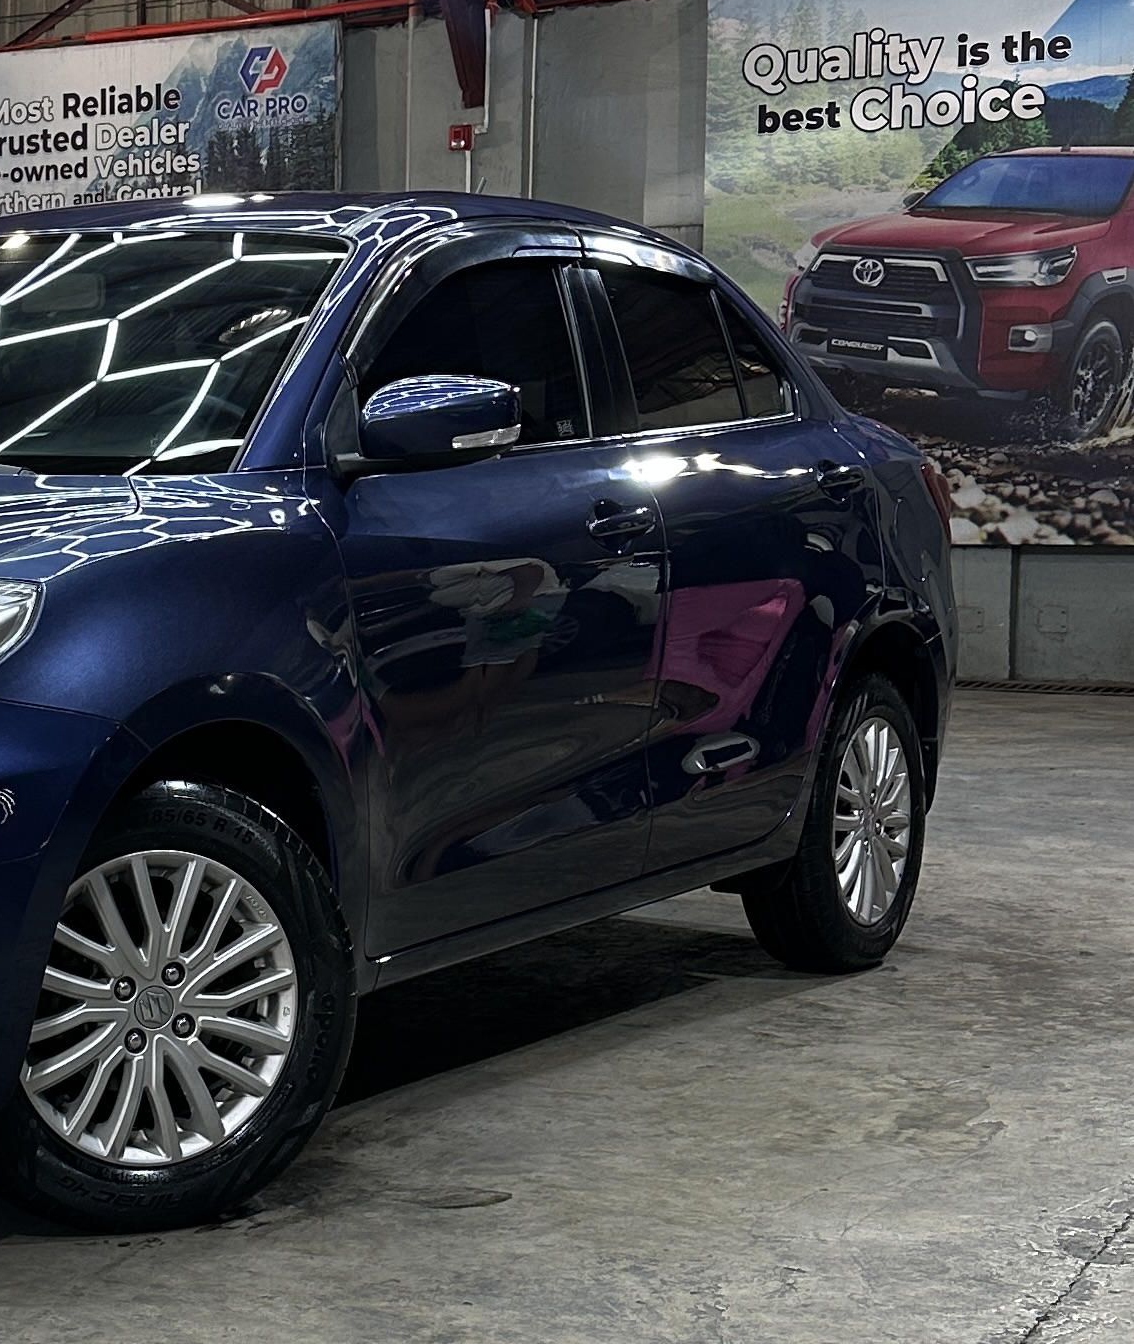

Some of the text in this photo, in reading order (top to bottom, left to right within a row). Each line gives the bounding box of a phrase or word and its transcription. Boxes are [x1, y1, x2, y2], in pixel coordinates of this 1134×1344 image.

[742, 27, 1072, 95] Quality is the
[62, 84, 181, 119] Reliable
[217, 94, 308, 120] CAR PRO
[757, 74, 1046, 135] best Choice
[94, 118, 190, 151] Dealer
[94, 151, 200, 179] Vehicles
[73, 188, 104, 205] and
